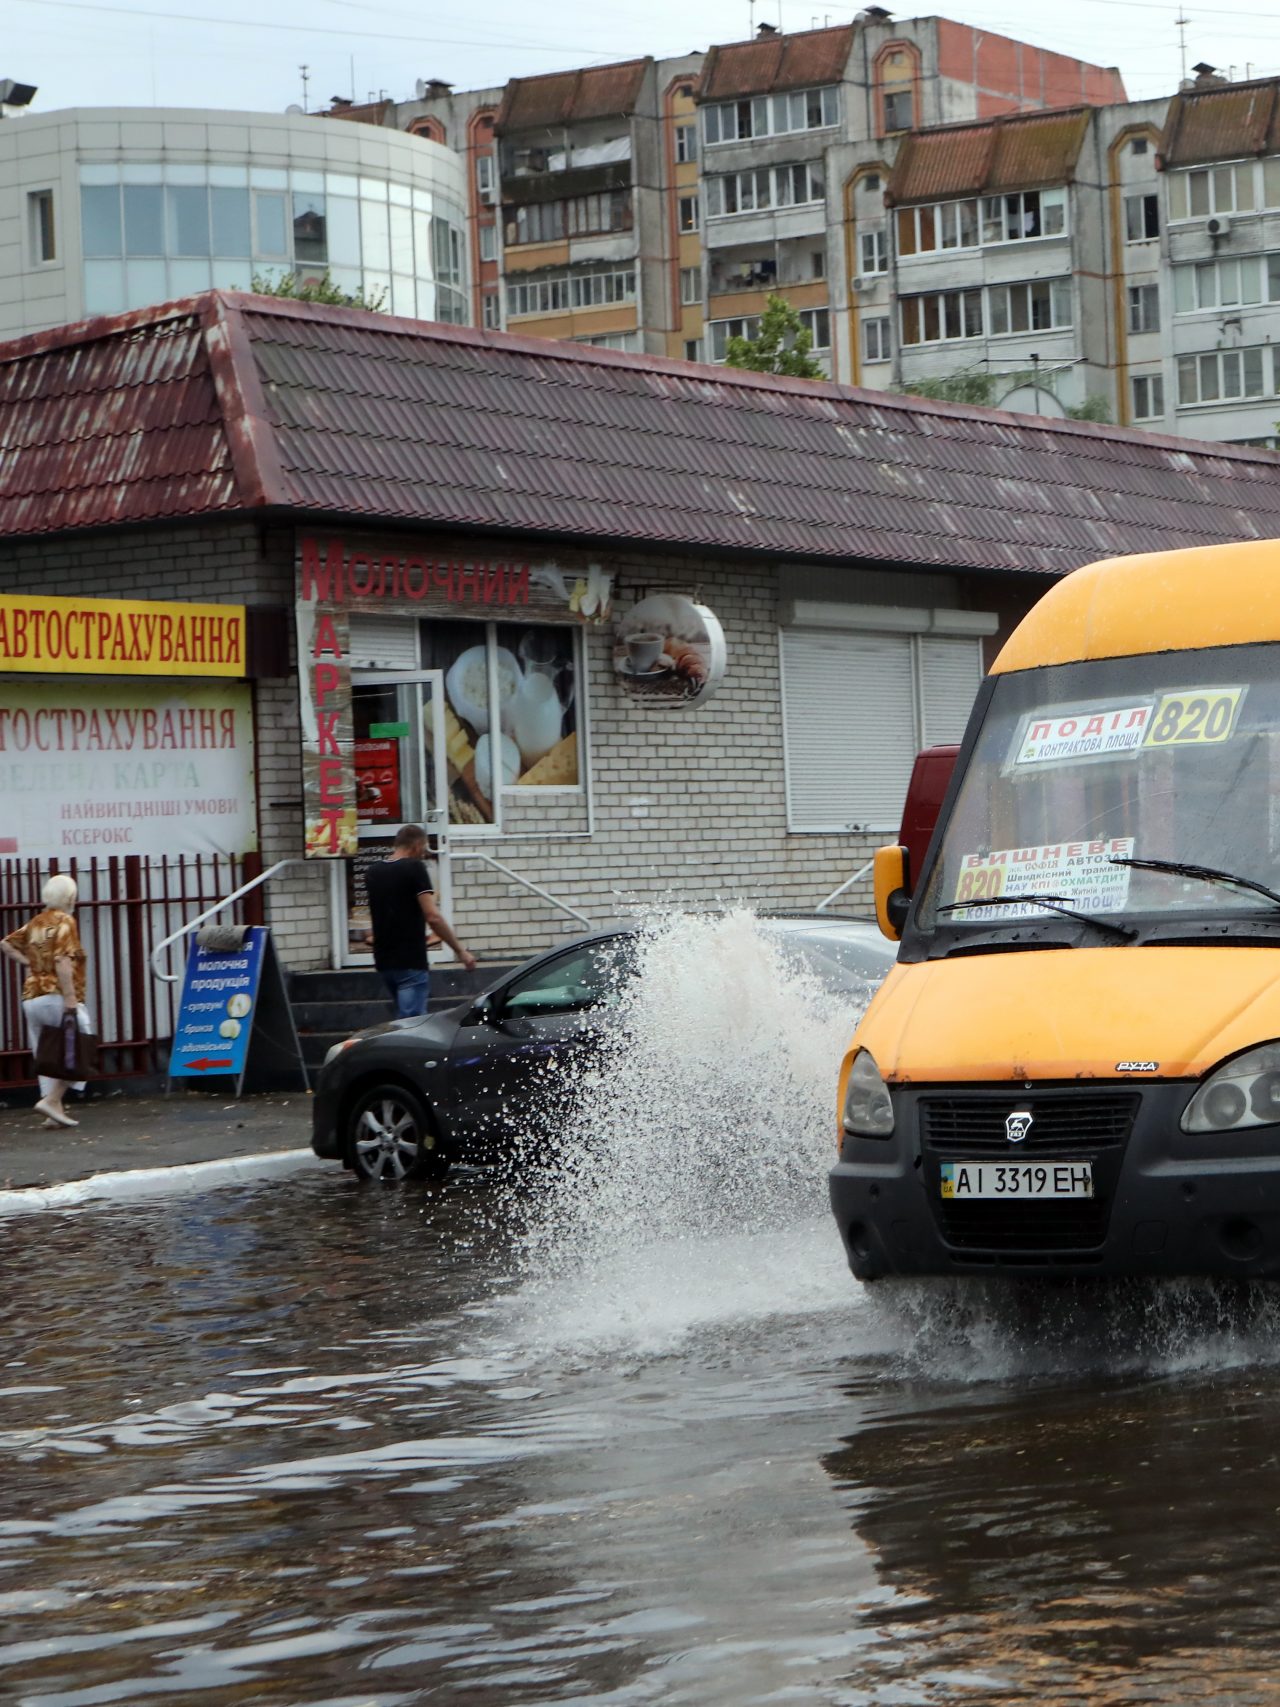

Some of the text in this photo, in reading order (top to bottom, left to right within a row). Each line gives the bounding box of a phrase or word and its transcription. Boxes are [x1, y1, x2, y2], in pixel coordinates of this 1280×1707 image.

[0, 608, 241, 664] АВТОСТРАХУВАННЯ
[1030, 709, 1148, 742] ПОДІЛ
[1153, 697, 1233, 743] 820
[1038, 732, 1139, 758] КОНТРАКТОВА ПЛОЩА
[113, 760, 201, 790] КАРТА
[61, 799, 239, 820] НАЙВИГІДНІШІ УМОВИ
[62, 827, 133, 846] КСЕРОКС
[967, 839, 1129, 868] ВИШНЕВЕ
[958, 868, 1002, 901] 820
[1007, 868, 1072, 883] Швидкісний
[1060, 873, 1126, 887] ОХМАТДИТ
[198, 959, 249, 971] молочна
[190, 974, 251, 992] продукція
[994, 1167, 1047, 1193] 3319
